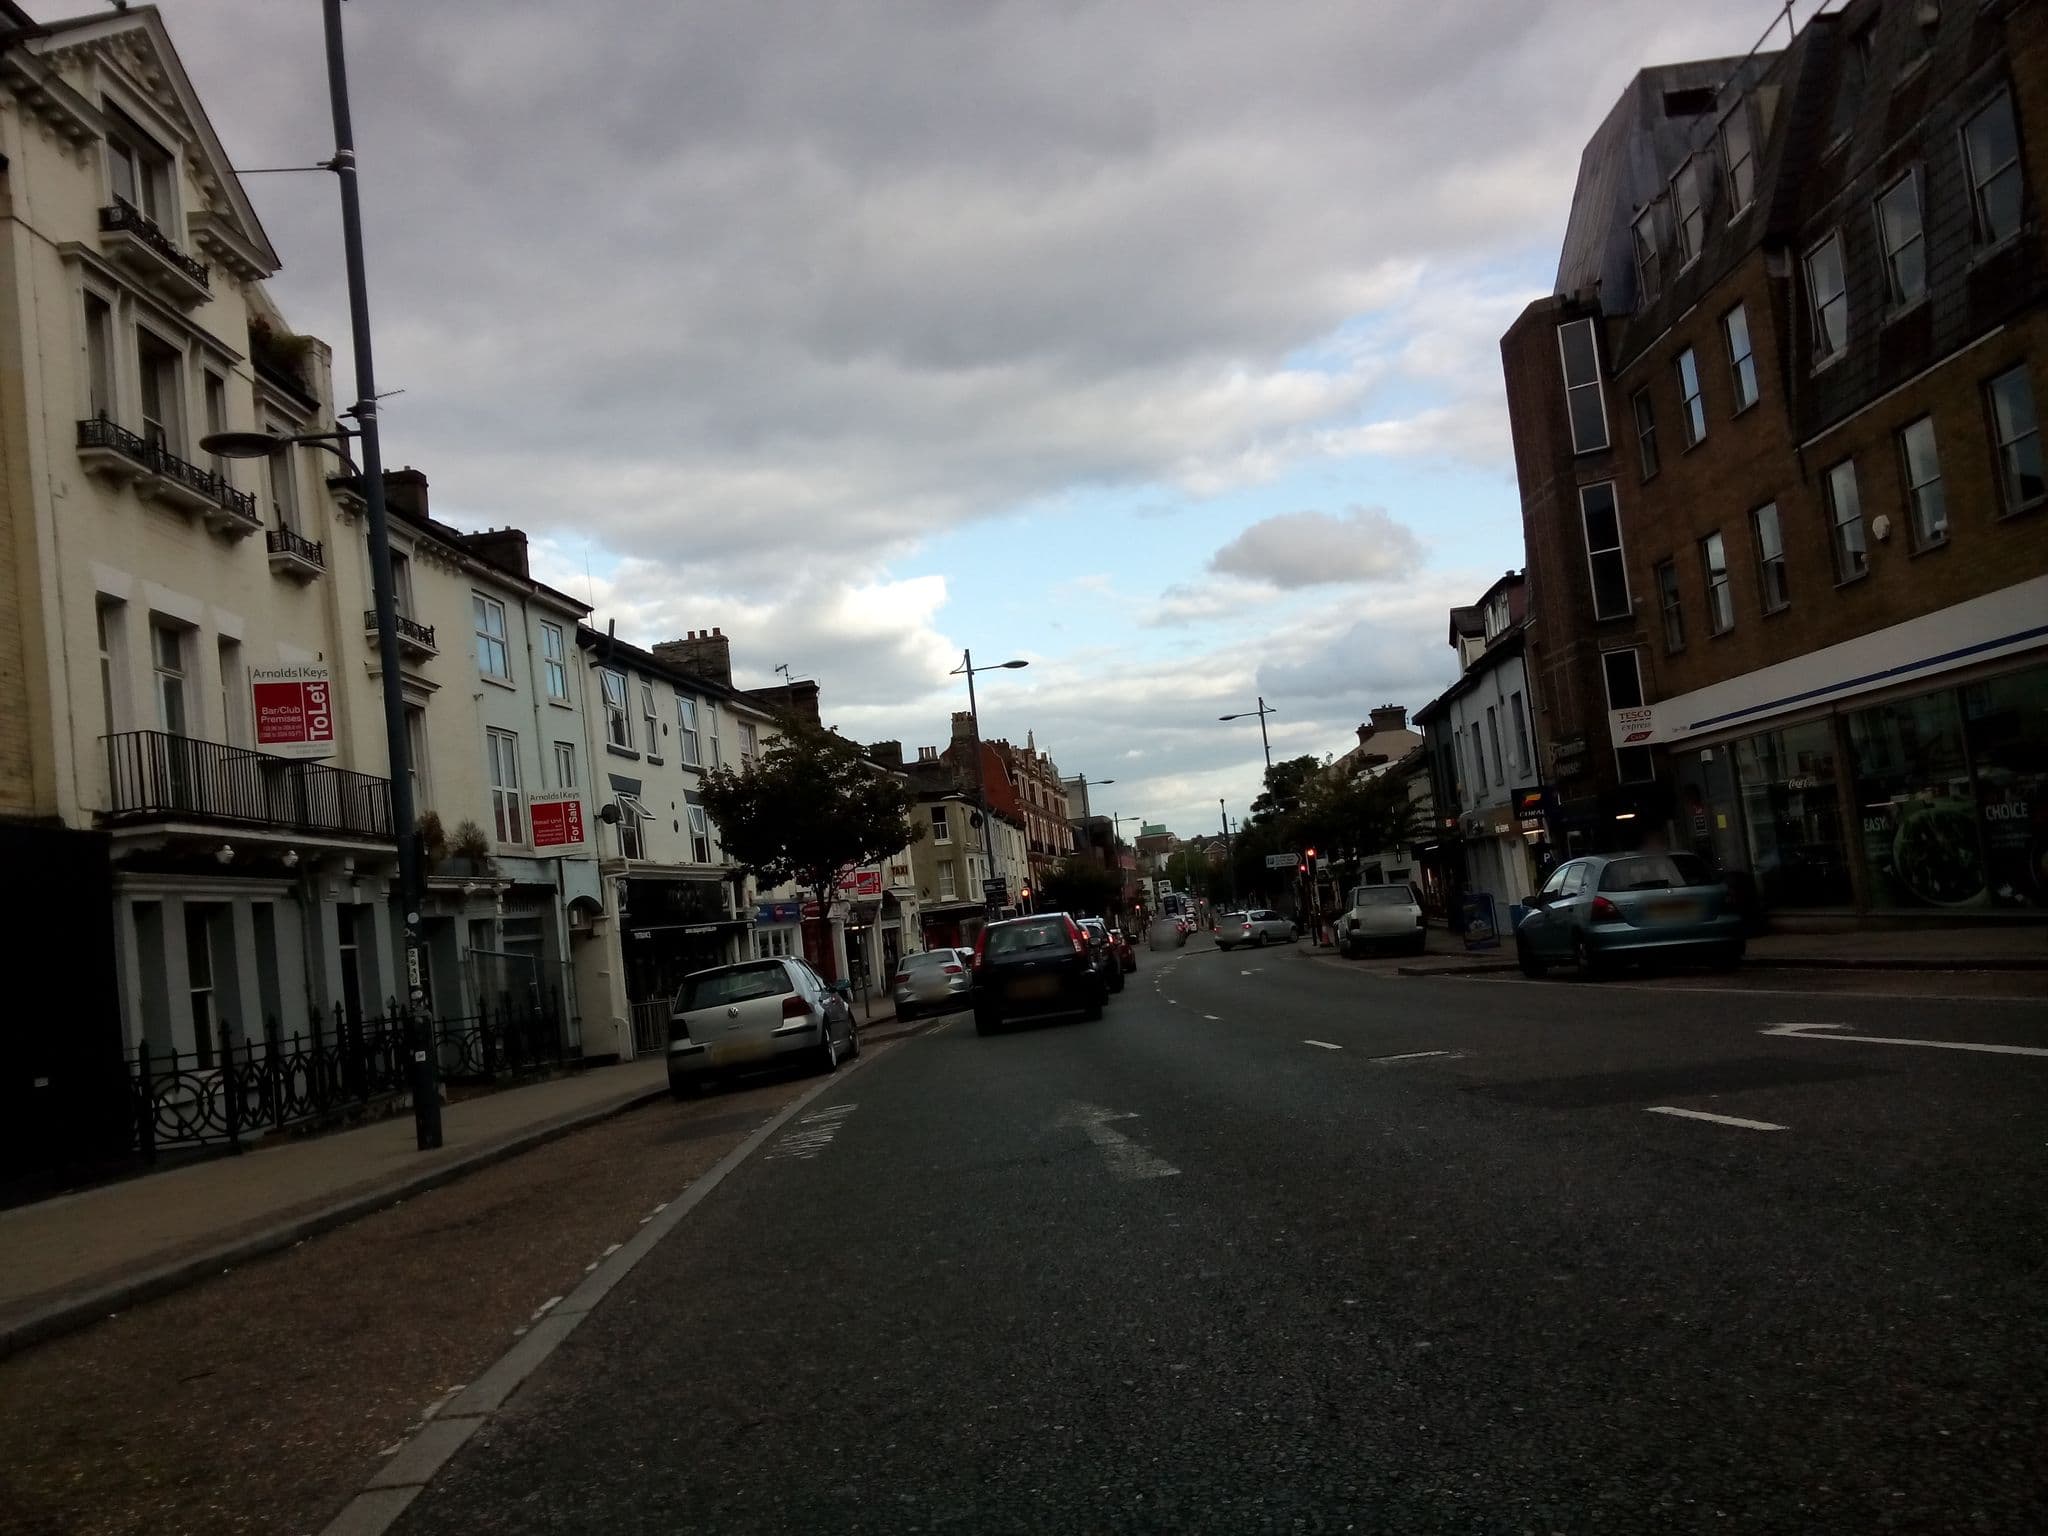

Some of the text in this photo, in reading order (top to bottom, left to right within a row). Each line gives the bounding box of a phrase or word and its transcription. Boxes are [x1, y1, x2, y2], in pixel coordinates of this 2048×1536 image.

[253, 668, 297, 678] Arnolds
[1619, 710, 1652, 720] TESCO
[1985, 802, 2029, 820] CHOICE
[891, 865, 908, 876] TAXI
